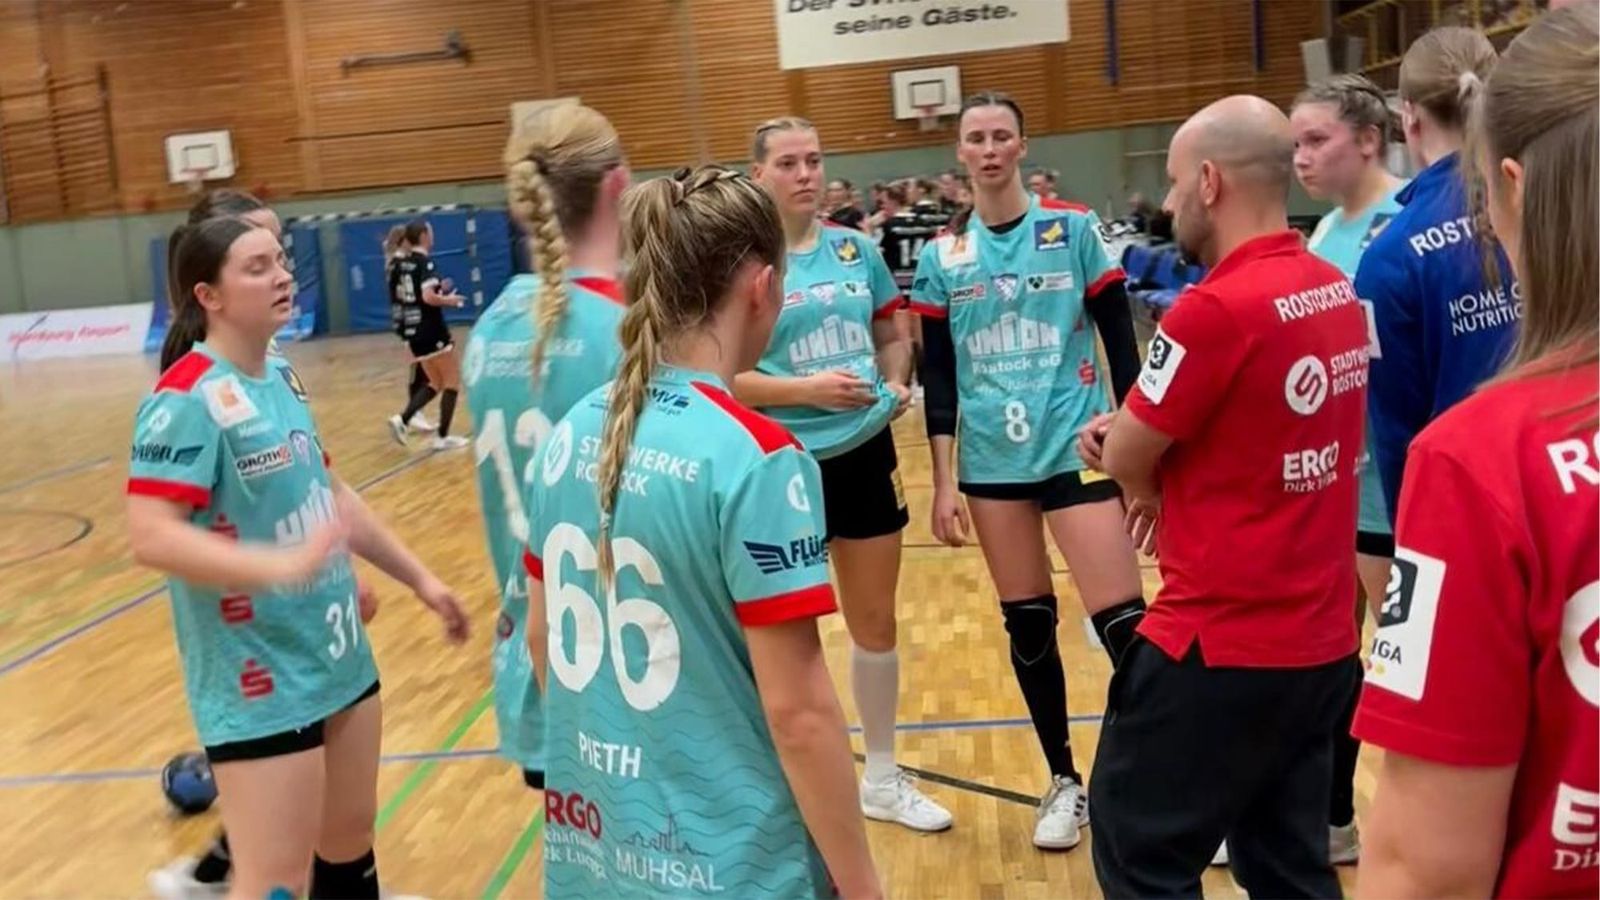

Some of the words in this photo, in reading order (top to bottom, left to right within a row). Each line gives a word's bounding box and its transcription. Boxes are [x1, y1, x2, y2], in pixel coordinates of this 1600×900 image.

[834, 14, 912, 35] seine
[922, 4, 1018, 26] Gäste.
[1410, 216, 1479, 256] ROST
[1449, 286, 1507, 319] HOME
[1005, 400, 1030, 443] 8
[325, 593, 358, 660] 31
[543, 522, 681, 711] 66
[578, 731, 642, 778] PIETH
[616, 847, 724, 891] MUHSAL
